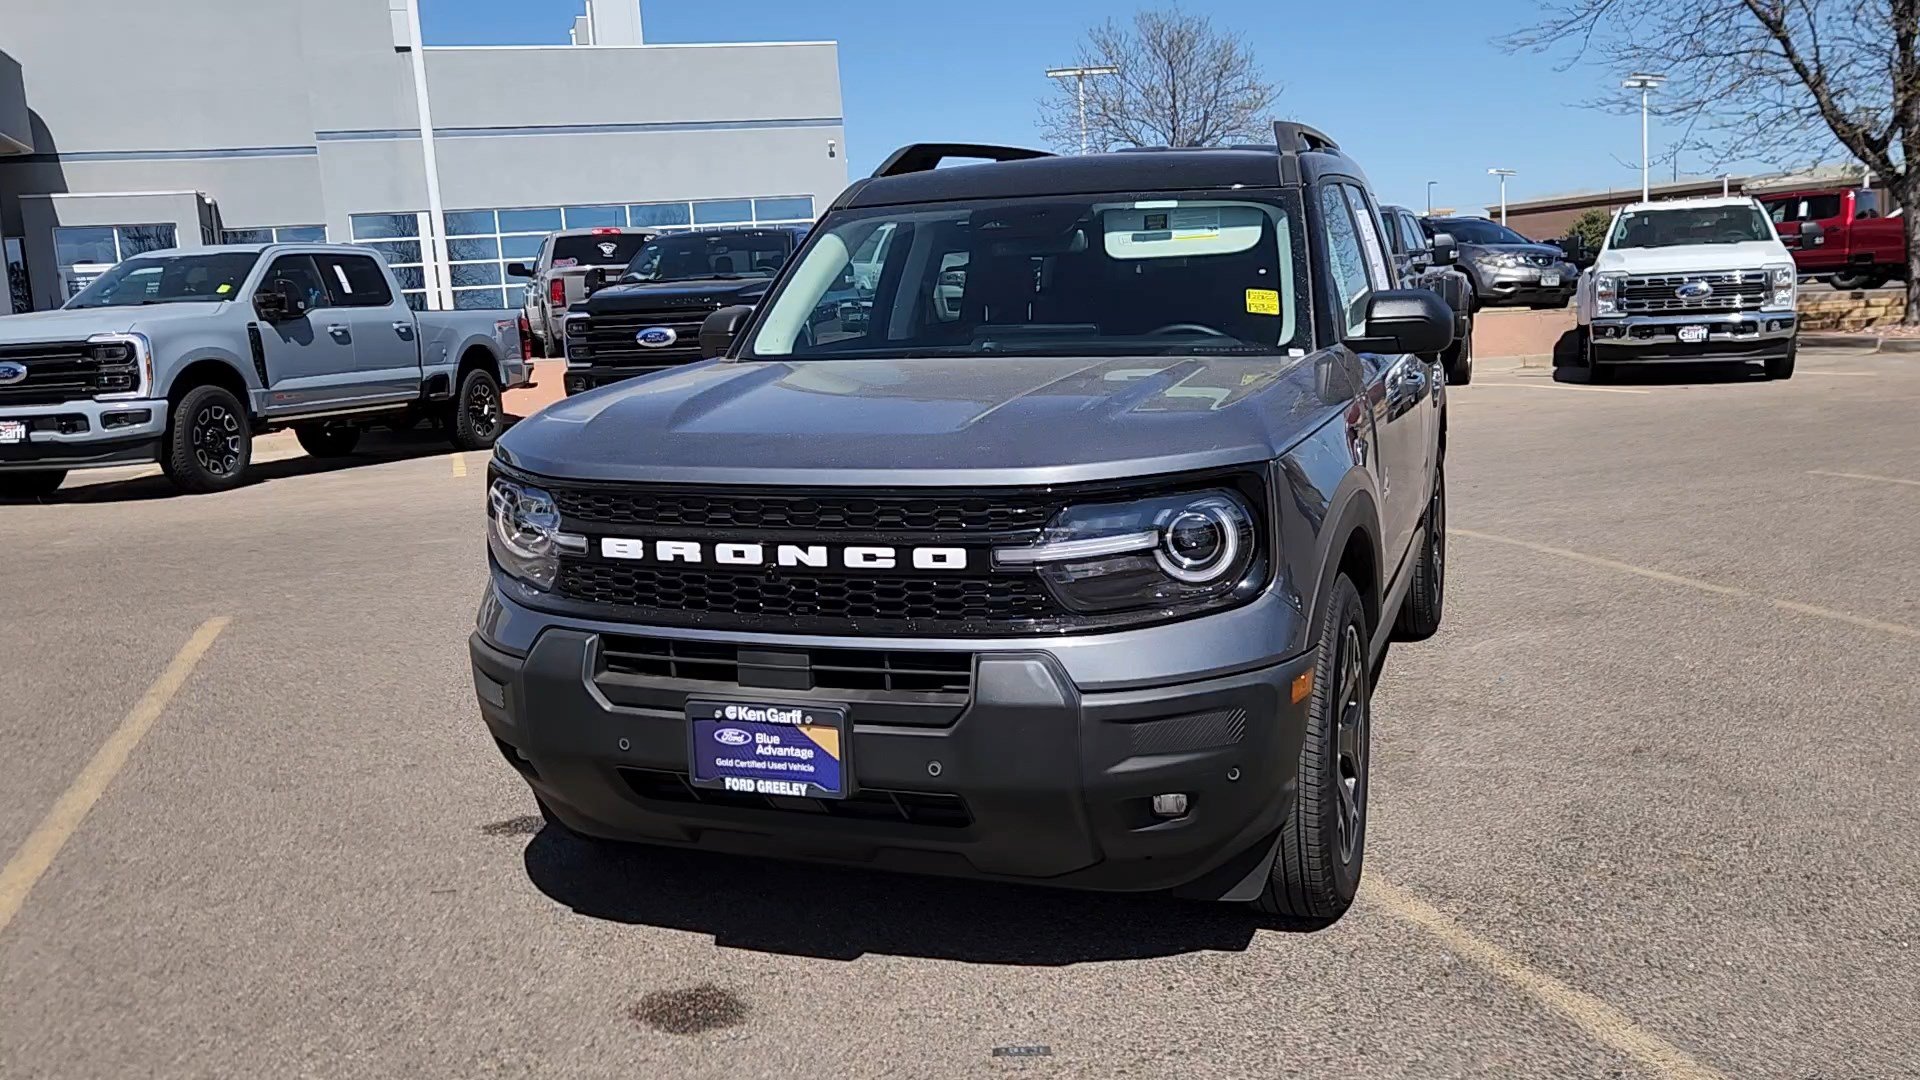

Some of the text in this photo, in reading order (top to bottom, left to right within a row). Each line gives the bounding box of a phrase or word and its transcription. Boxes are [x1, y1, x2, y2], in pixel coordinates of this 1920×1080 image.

[601, 537, 967, 570] BRONCO
[737, 706, 802, 724] Ken Garff
[721, 730, 745, 743] Ford
[755, 732, 780, 744] Blue
[756, 744, 814, 759] Advantage
[715, 757, 815, 773] Gold Certified Used Vehicle
[725, 777, 808, 797] FORD GREELEY
